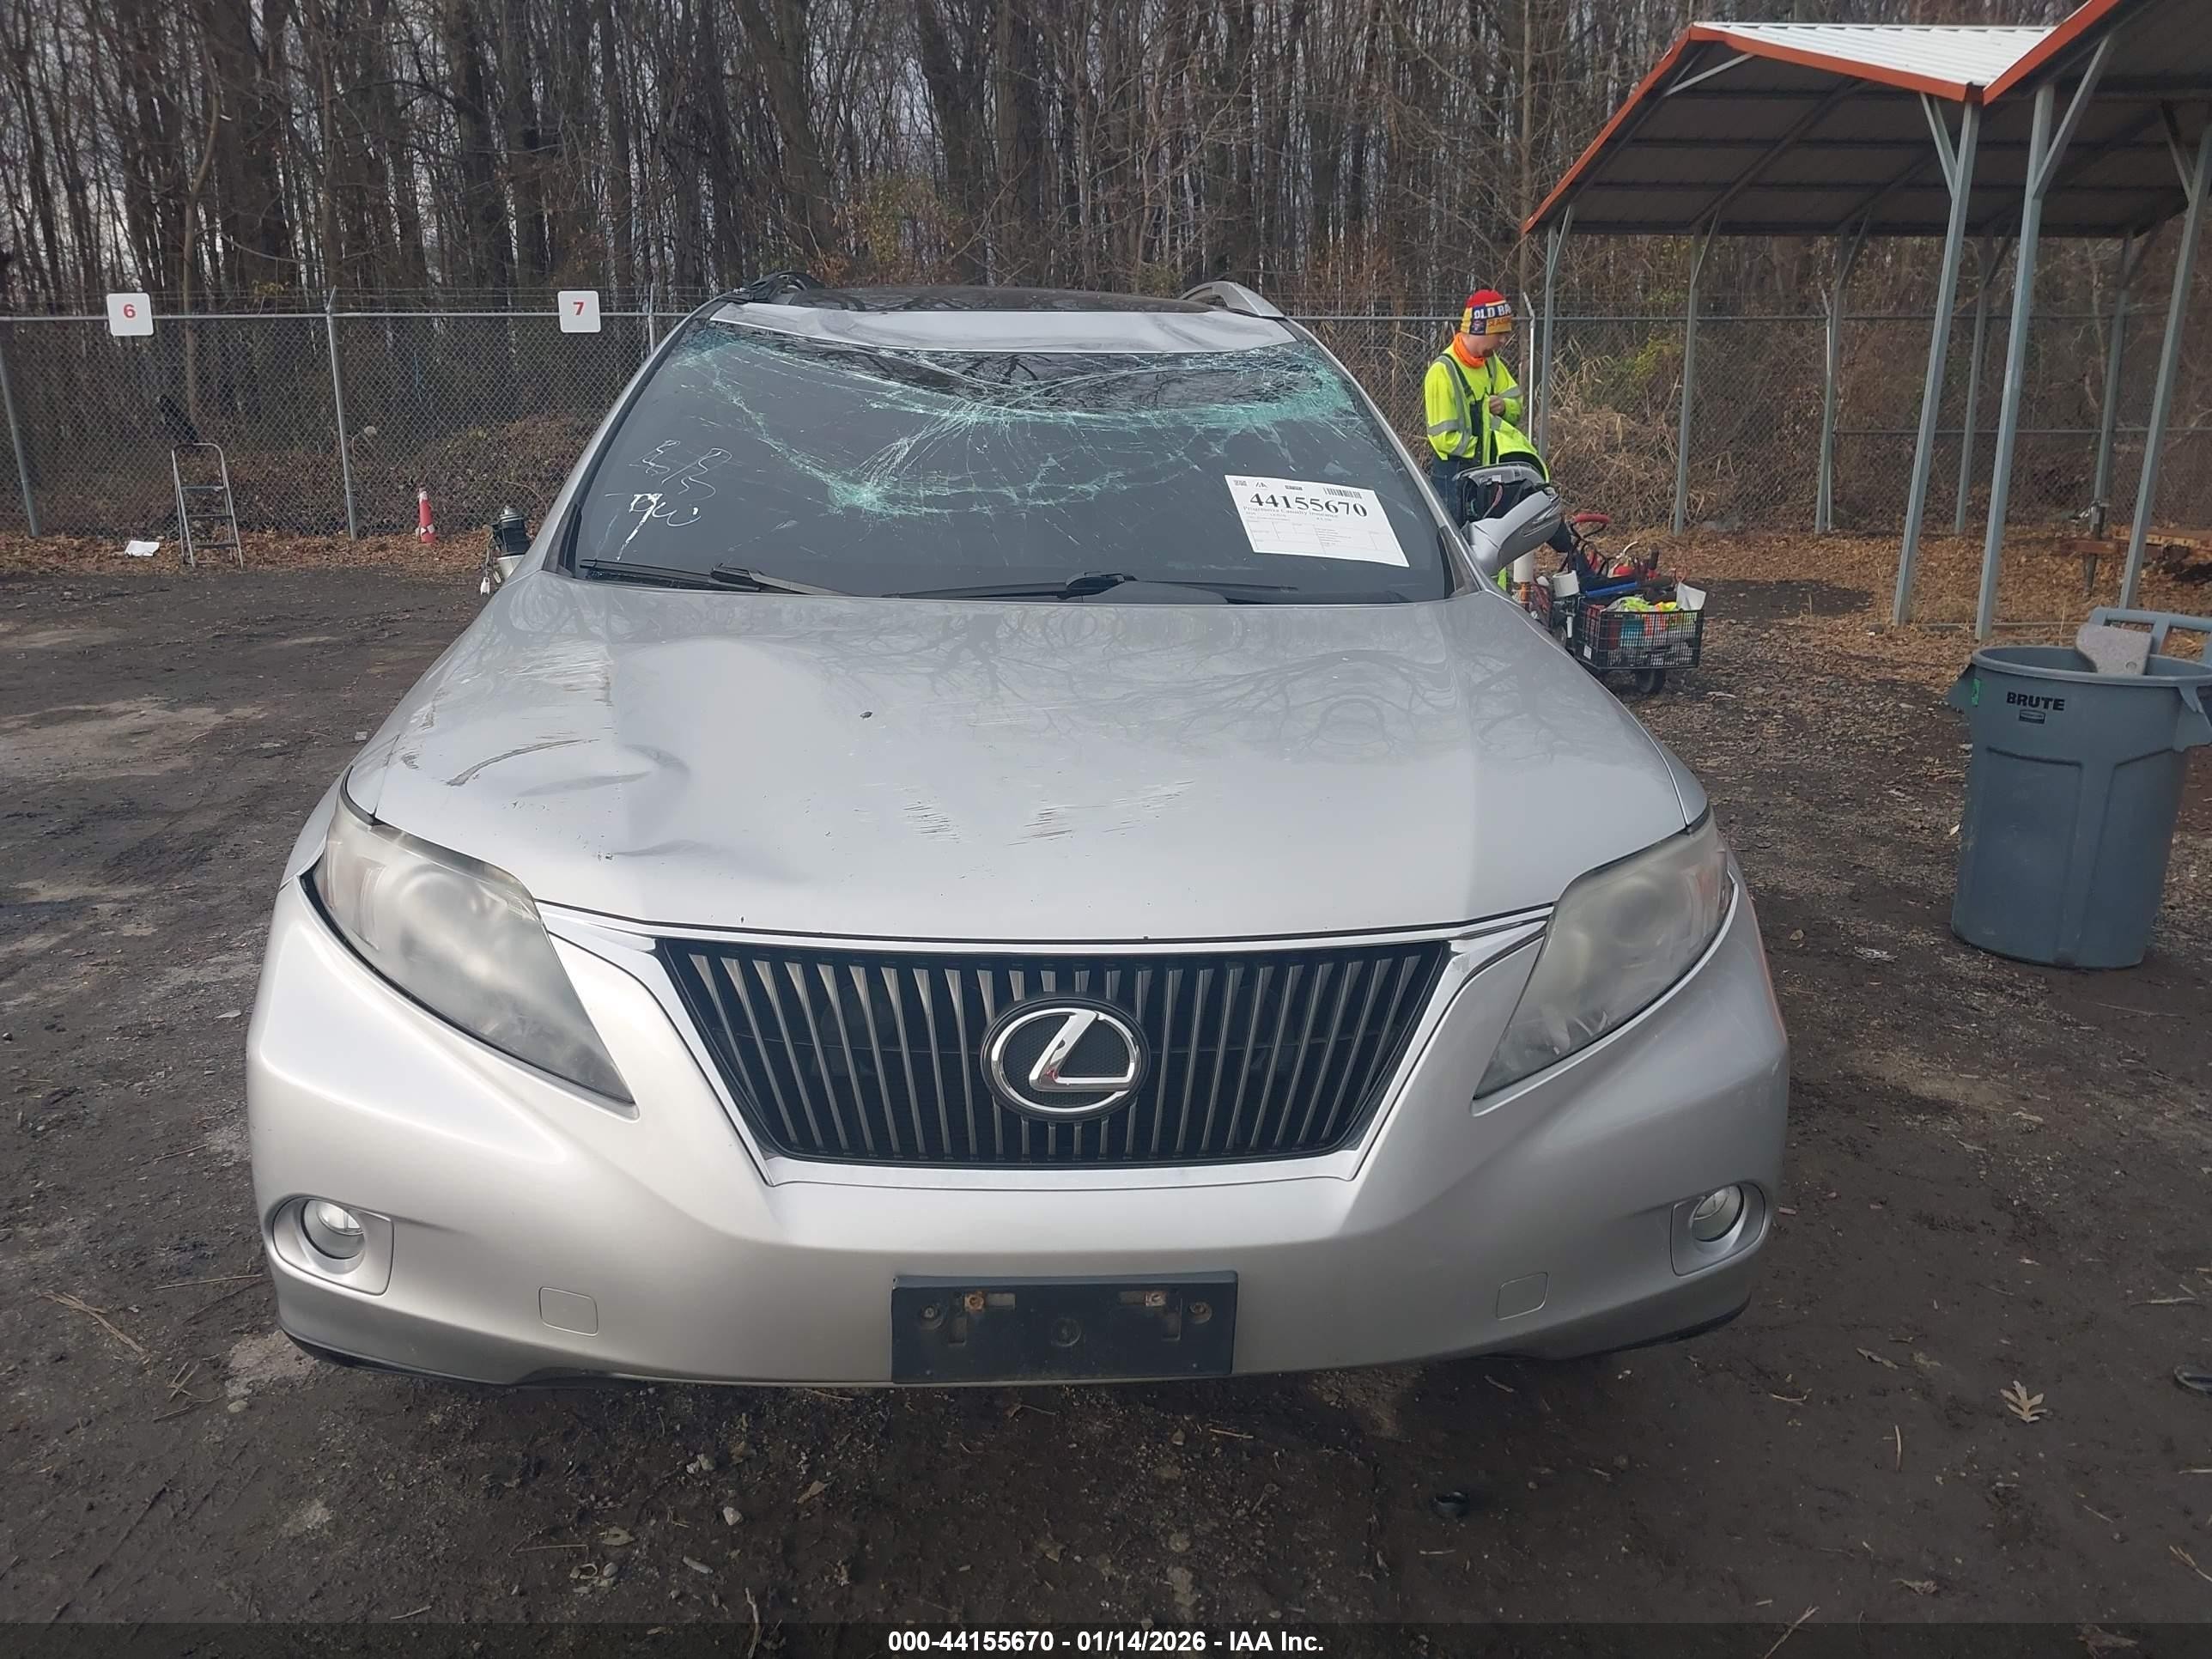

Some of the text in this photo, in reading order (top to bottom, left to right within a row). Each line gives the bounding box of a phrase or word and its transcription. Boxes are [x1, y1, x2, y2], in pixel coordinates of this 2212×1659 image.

[123, 303, 137, 319] 6
[573, 301, 585, 316] 7
[1474, 307, 1496, 319] OLD
[1249, 493, 1368, 517] 44155670
[2007, 691, 2065, 711] BRUTE
